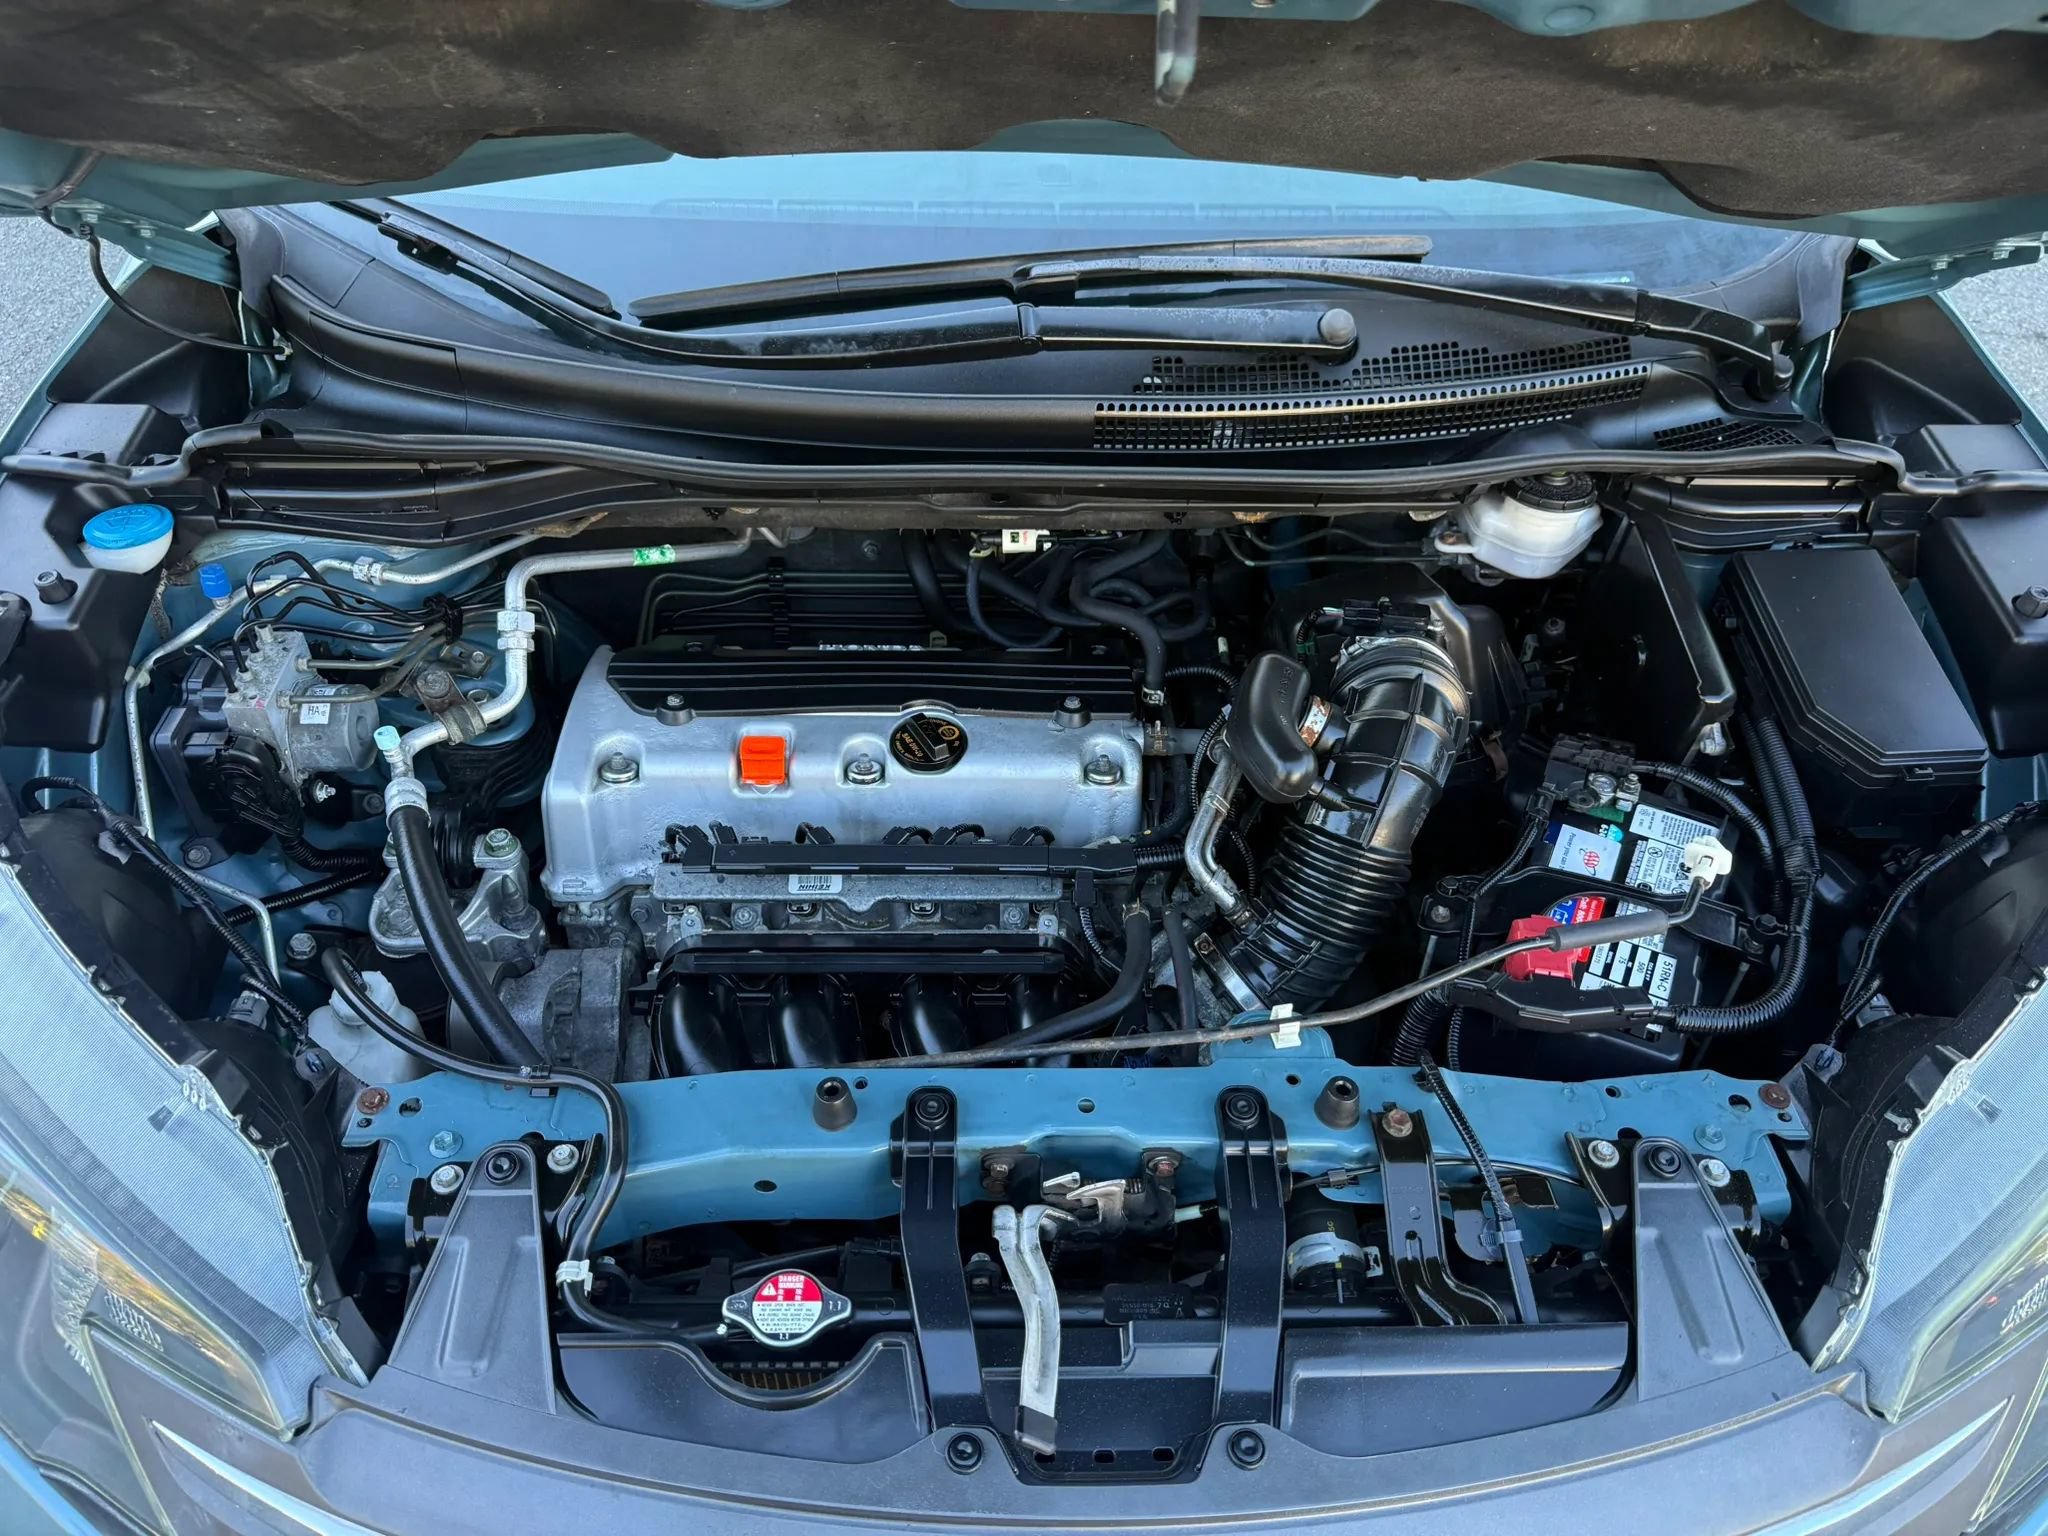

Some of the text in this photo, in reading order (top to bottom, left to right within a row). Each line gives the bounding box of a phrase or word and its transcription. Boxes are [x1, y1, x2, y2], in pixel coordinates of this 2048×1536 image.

[1566, 831, 1576, 847] Power
[1561, 846, 1570, 856] you
[1618, 955, 1626, 964] 75
[1636, 961, 1646, 973] 500
[1655, 960, 1673, 992] 51RN-C
[829, 1300, 841, 1311] 1.1
